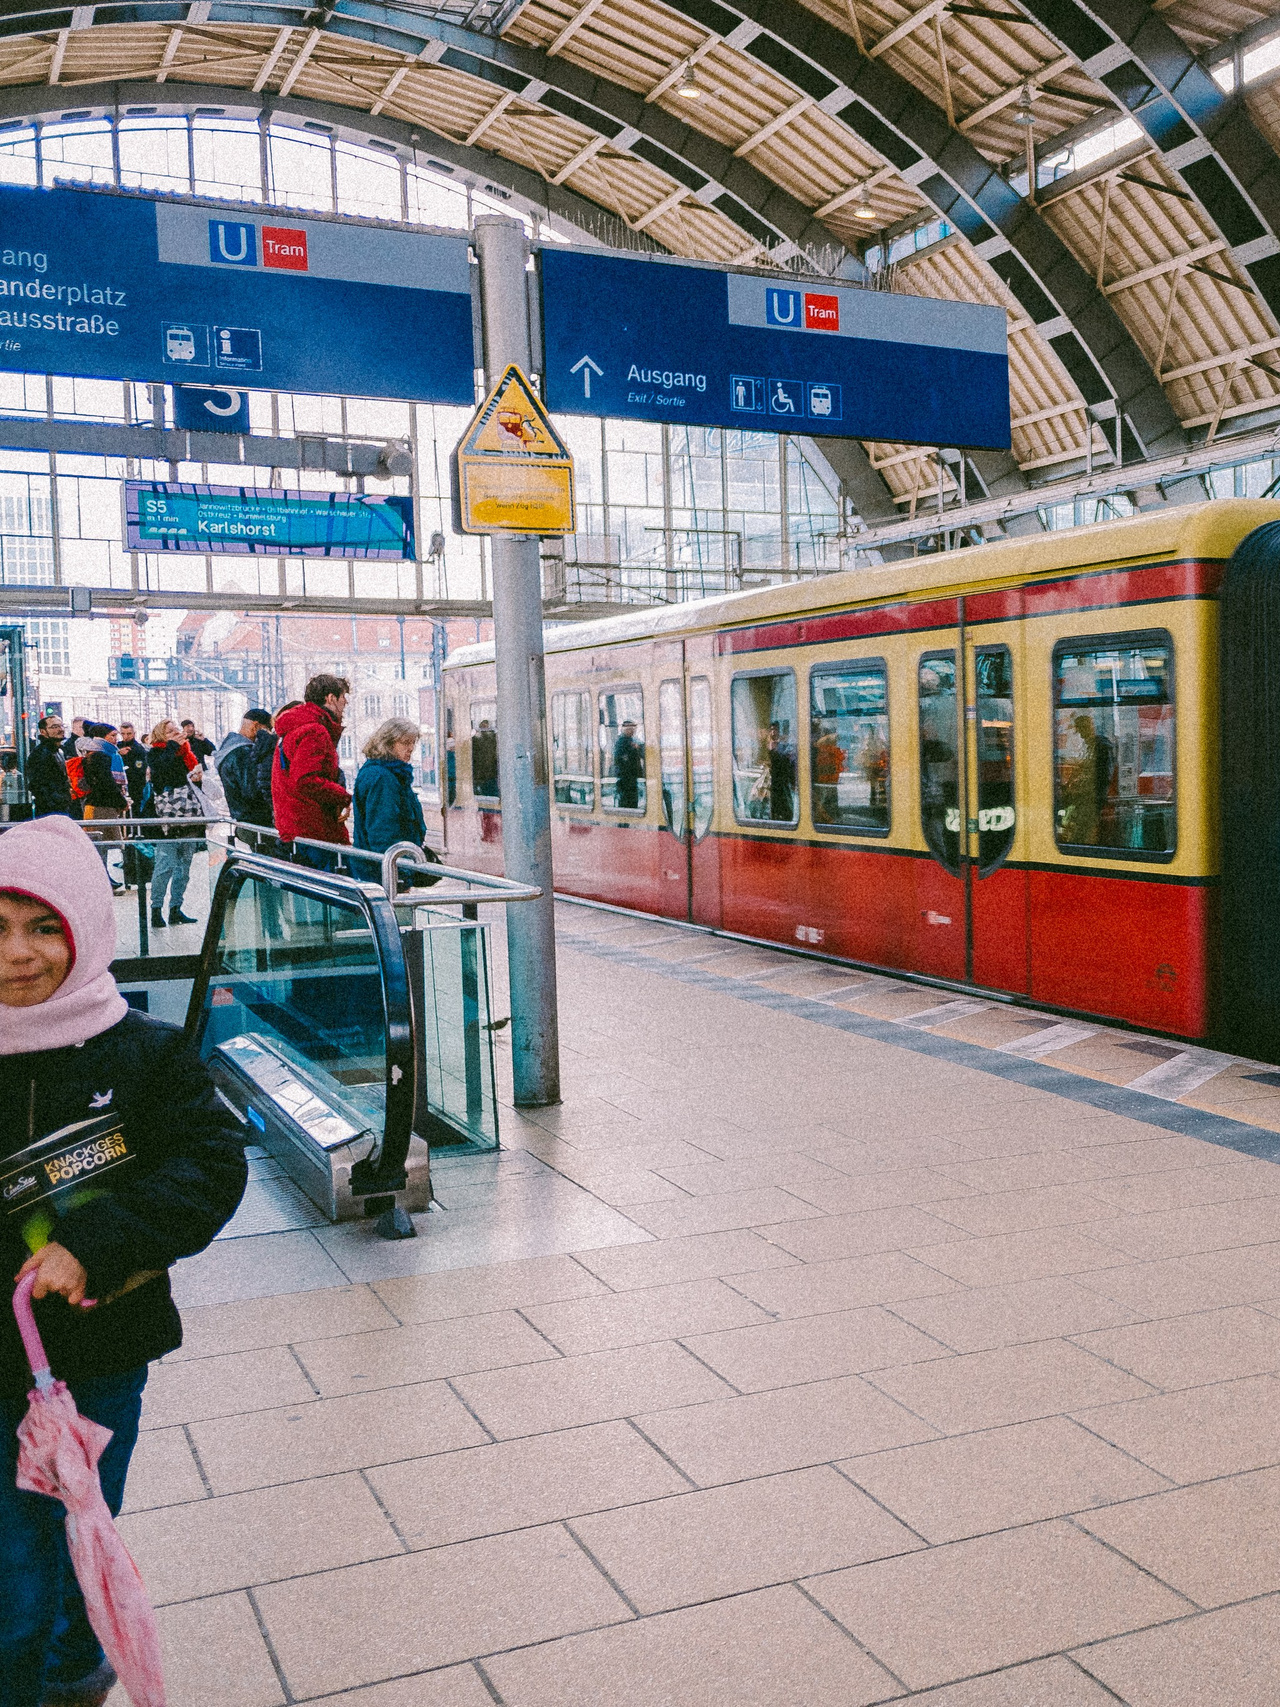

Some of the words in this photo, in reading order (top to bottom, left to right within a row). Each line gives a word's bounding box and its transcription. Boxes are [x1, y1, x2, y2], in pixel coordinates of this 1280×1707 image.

[218, 224, 248, 261] U
[265, 239, 304, 257] Tram
[2, 249, 48, 273] ang
[0, 278, 127, 307] anderplatz
[772, 292, 795, 324] U
[807, 304, 837, 319] Tram
[0, 310, 120, 336] ausstraße
[627, 364, 707, 392] Ausgang
[627, 392, 647, 404] Exit
[656, 394, 686, 407] Sortie
[146, 499, 167, 514] S5
[198, 519, 276, 537] Karlshorst
[44, 1132, 124, 1174] KNACKIGES
[48, 1142, 128, 1185] POPCORN
